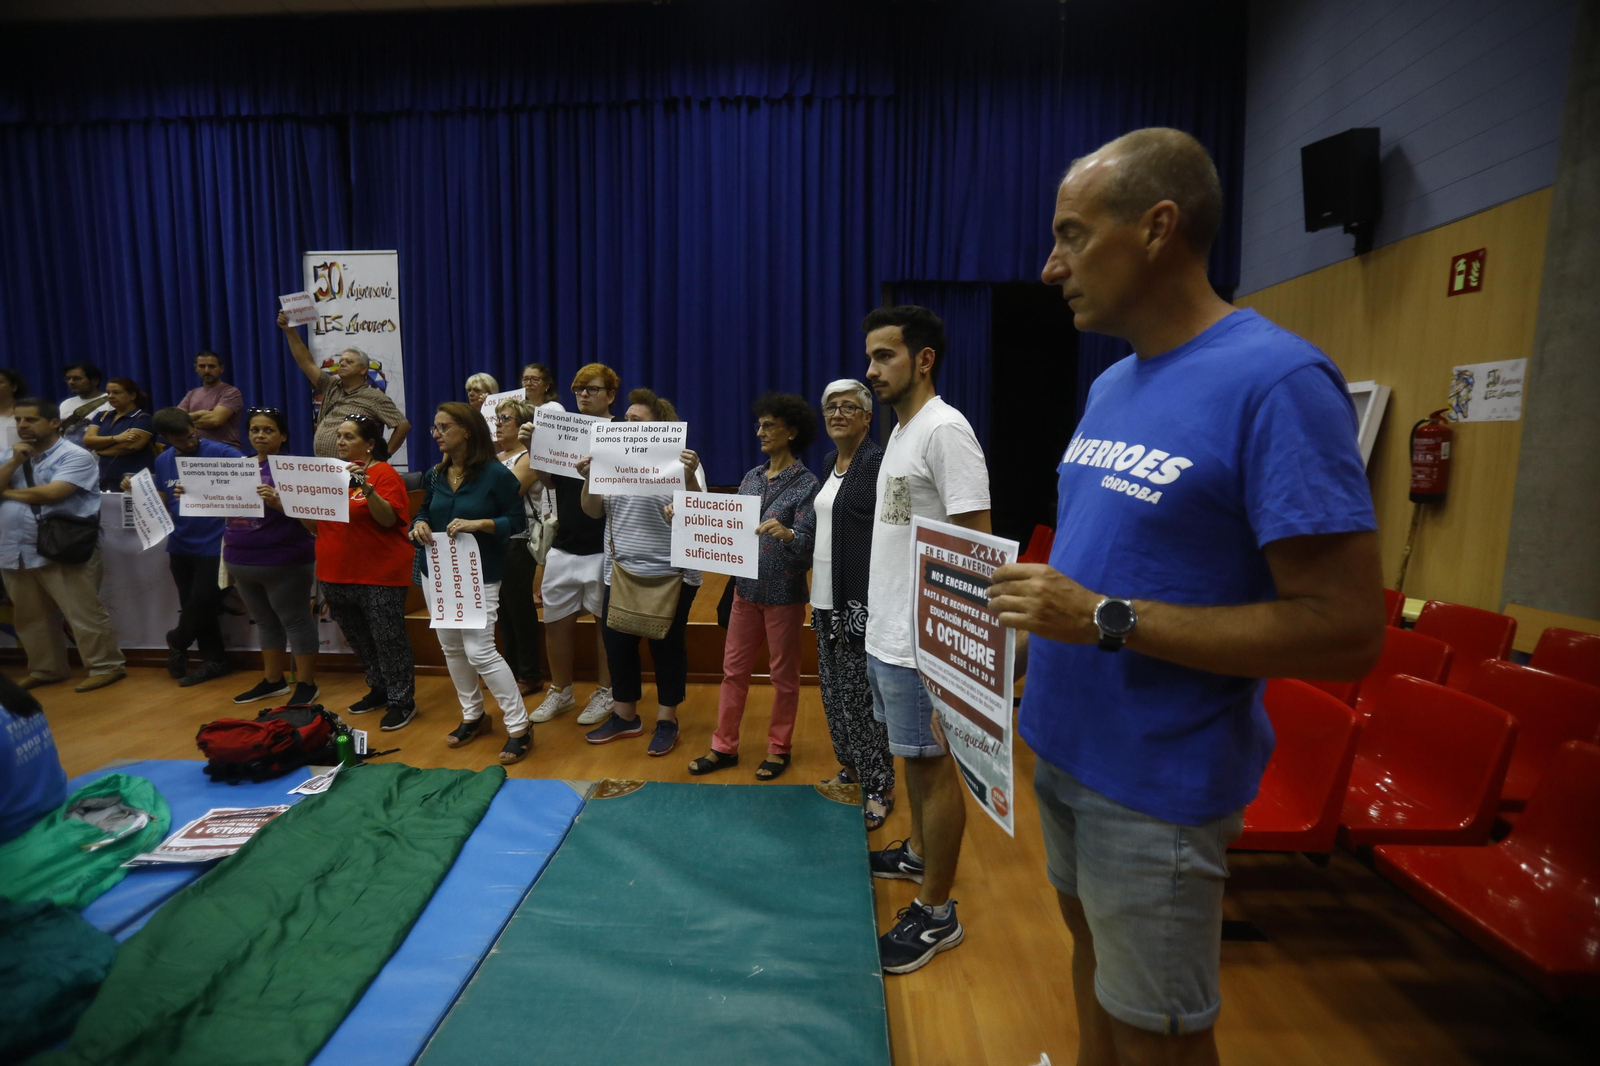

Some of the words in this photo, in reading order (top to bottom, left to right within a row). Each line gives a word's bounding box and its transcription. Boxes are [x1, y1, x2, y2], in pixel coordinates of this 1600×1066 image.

[537, 410, 543, 418] El
[543, 412, 572, 423] personal
[573, 416, 597, 427] labora
[536, 420, 555, 429] somos
[557, 424, 579, 433] trapos
[580, 427, 589, 435] de
[596, 425, 604, 433] El
[605, 425, 640, 434] personal
[641, 425, 670, 433] laboral
[558, 433, 563, 441] y
[564, 433, 579, 442] tirar
[623, 436, 648, 444] trapos
[650, 435, 661, 443] de
[548, 448, 569, 458] Vuelta
[570, 452, 579, 460] de
[625, 446, 630, 454] y
[1063, 431, 1194, 485] AVERROES
[189, 461, 219, 469] personal
[275, 460, 295, 471] Los
[297, 463, 343, 474] recortes
[533, 454, 567, 468] compañera
[614, 466, 638, 474] Vuelta
[640, 466, 650, 474] de
[278, 481, 294, 492] los
[296, 484, 344, 496] pagamos
[594, 476, 638, 485] compañera
[639, 477, 681, 485] trasladada
[1101, 473, 1163, 504] CÓRDOBA
[292, 505, 336, 516] nosotras
[685, 496, 743, 512] Educación
[684, 513, 723, 527] pública
[726, 517, 744, 530] sin
[694, 532, 734, 546] medios
[685, 547, 744, 565] suficientes
[925, 546, 935, 557] EN
[936, 549, 945, 560] EL
[947, 552, 959, 565] IES
[961, 557, 996, 577] AVERROE
[431, 540, 443, 593] recortes
[449, 538, 464, 599] pagamos
[469, 551, 482, 609] nosotras
[931, 570, 944, 583] NOS
[945, 575, 992, 601] ENCERRAMO
[435, 597, 445, 621] Los
[454, 602, 464, 622] los
[923, 588, 940, 601] BASTA
[941, 595, 949, 605] DE
[949, 599, 980, 619] RECORTES
[980, 612, 990, 623] EN
[991, 616, 1000, 627] LA
[930, 604, 962, 627] EDUCACIÓN
[962, 619, 989, 641] PÚBLICA
[925, 617, 934, 637] 4
[937, 622, 996, 671] OCTUBRE
[950, 653, 968, 669] DESDE
[968, 664, 980, 677] LAS
[981, 671, 989, 682] 20
[990, 676, 996, 686] H
[954, 727, 963, 739] se
